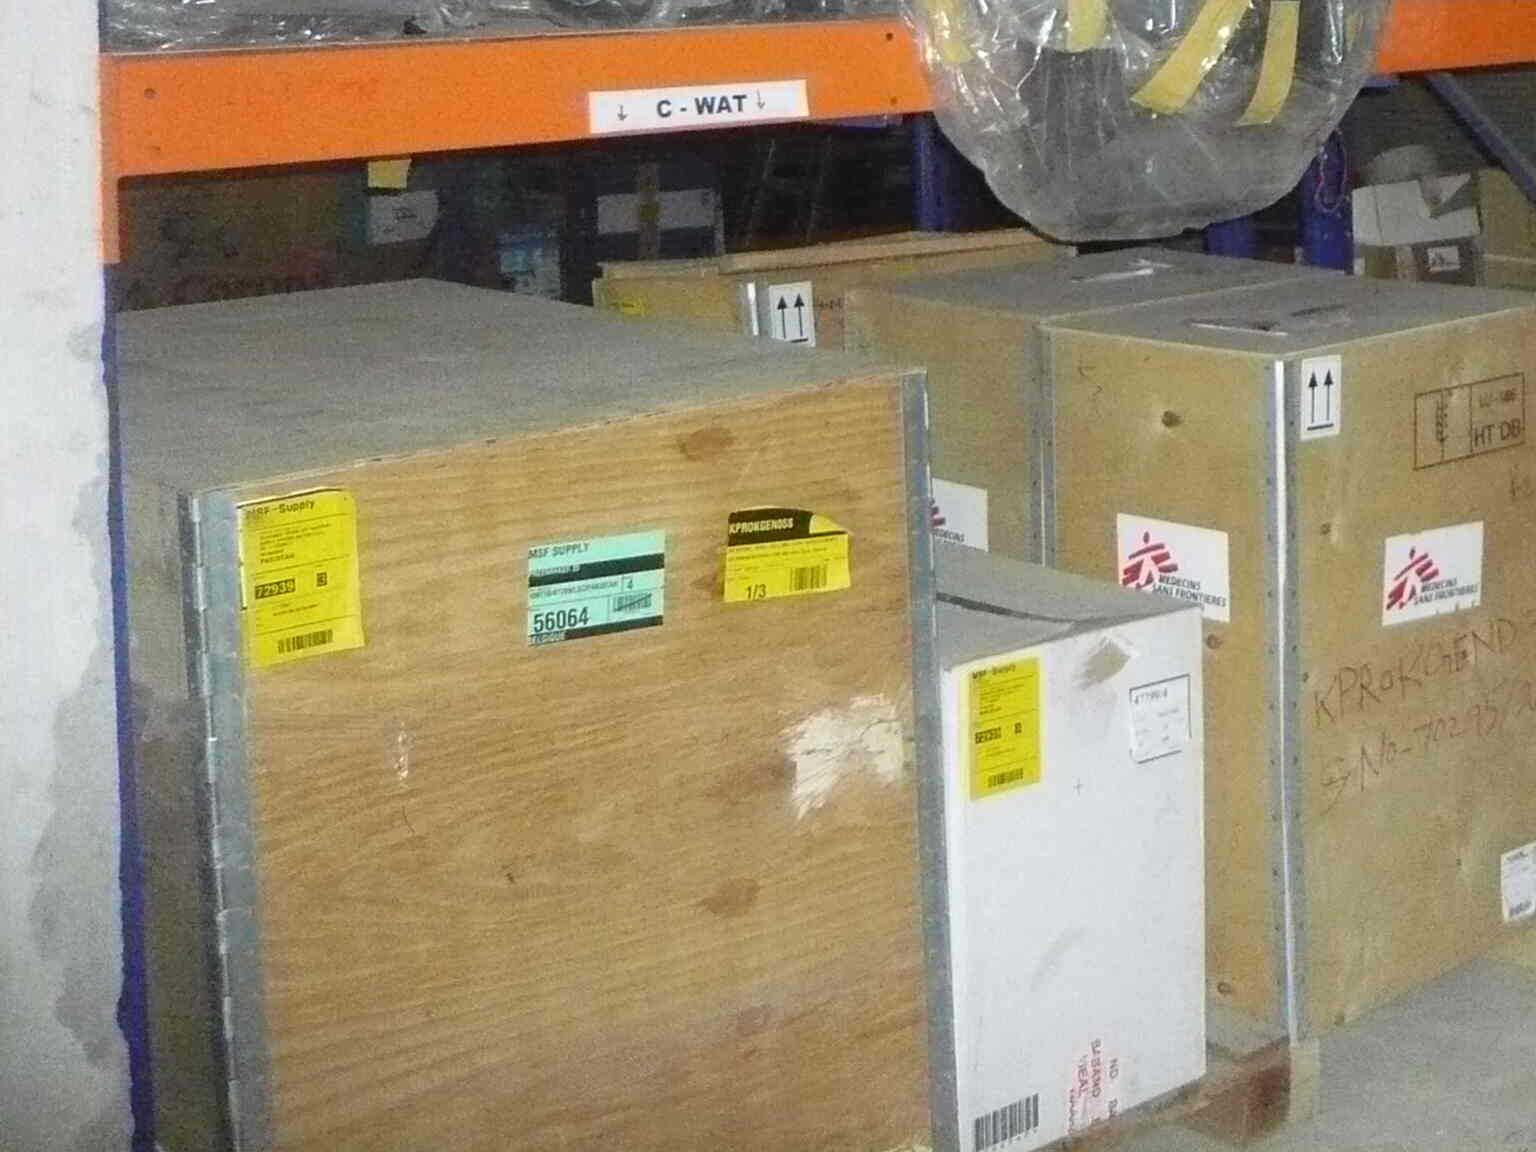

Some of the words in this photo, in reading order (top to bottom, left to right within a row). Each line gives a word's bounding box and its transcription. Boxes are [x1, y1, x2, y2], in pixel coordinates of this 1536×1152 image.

[656, 99, 673, 118] C
[694, 94, 748, 116] WAT
[552, 542, 590, 557] SUPPLY
[746, 583, 767, 600] 1/3
[533, 606, 590, 633] 56064
